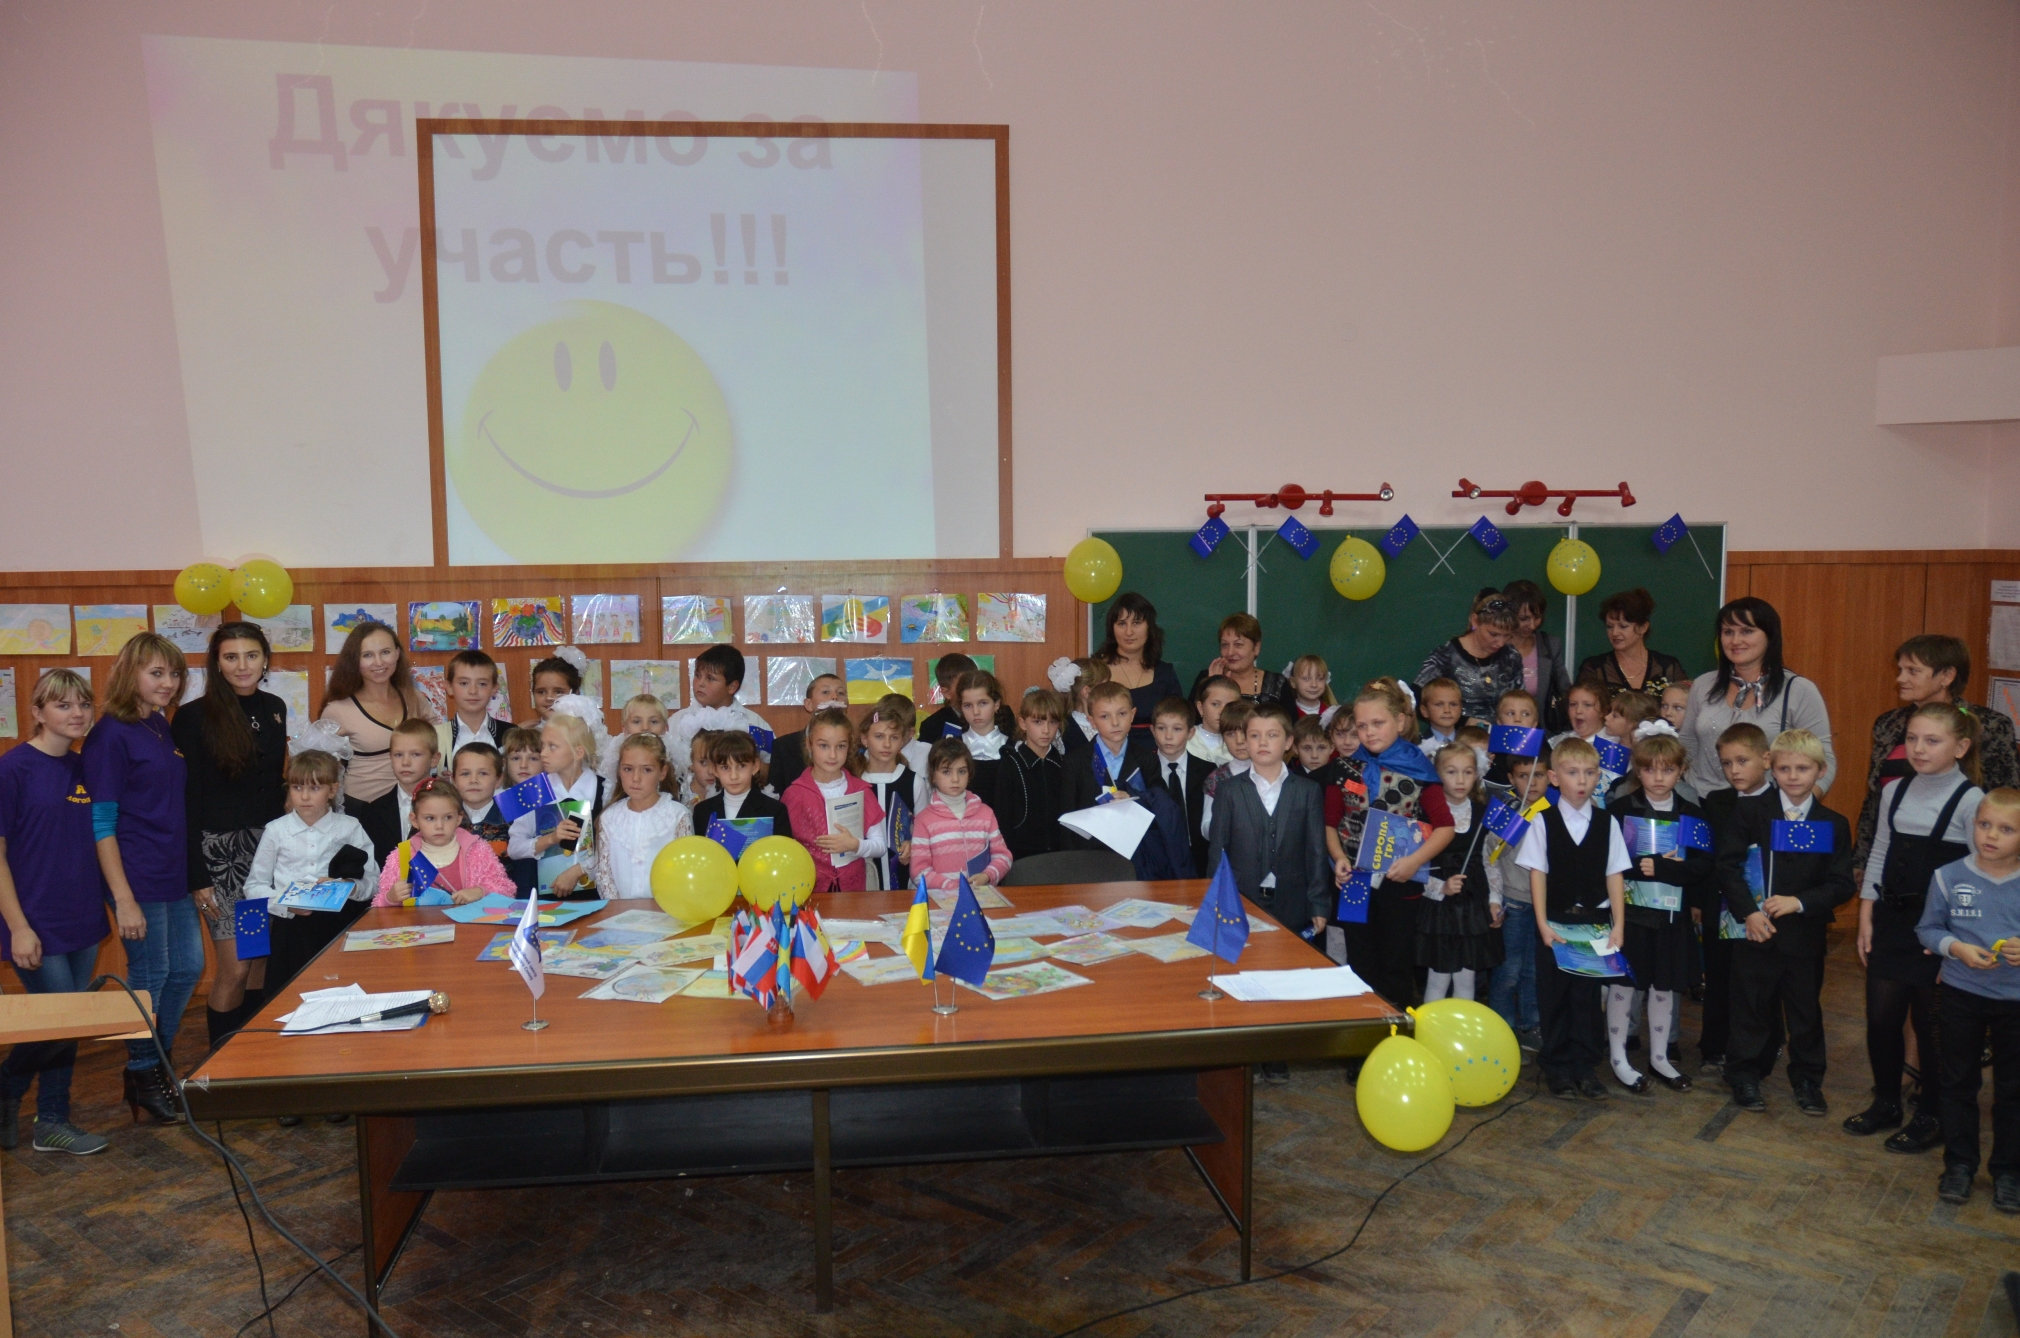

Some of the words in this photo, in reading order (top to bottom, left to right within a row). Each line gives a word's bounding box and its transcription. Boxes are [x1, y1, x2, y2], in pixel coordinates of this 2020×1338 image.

[736, 107, 835, 170] за
[364, 212, 790, 303] участь!!!
[1372, 816, 1389, 870] ЄВРОПА-
[1384, 836, 1396, 859] ГРА
